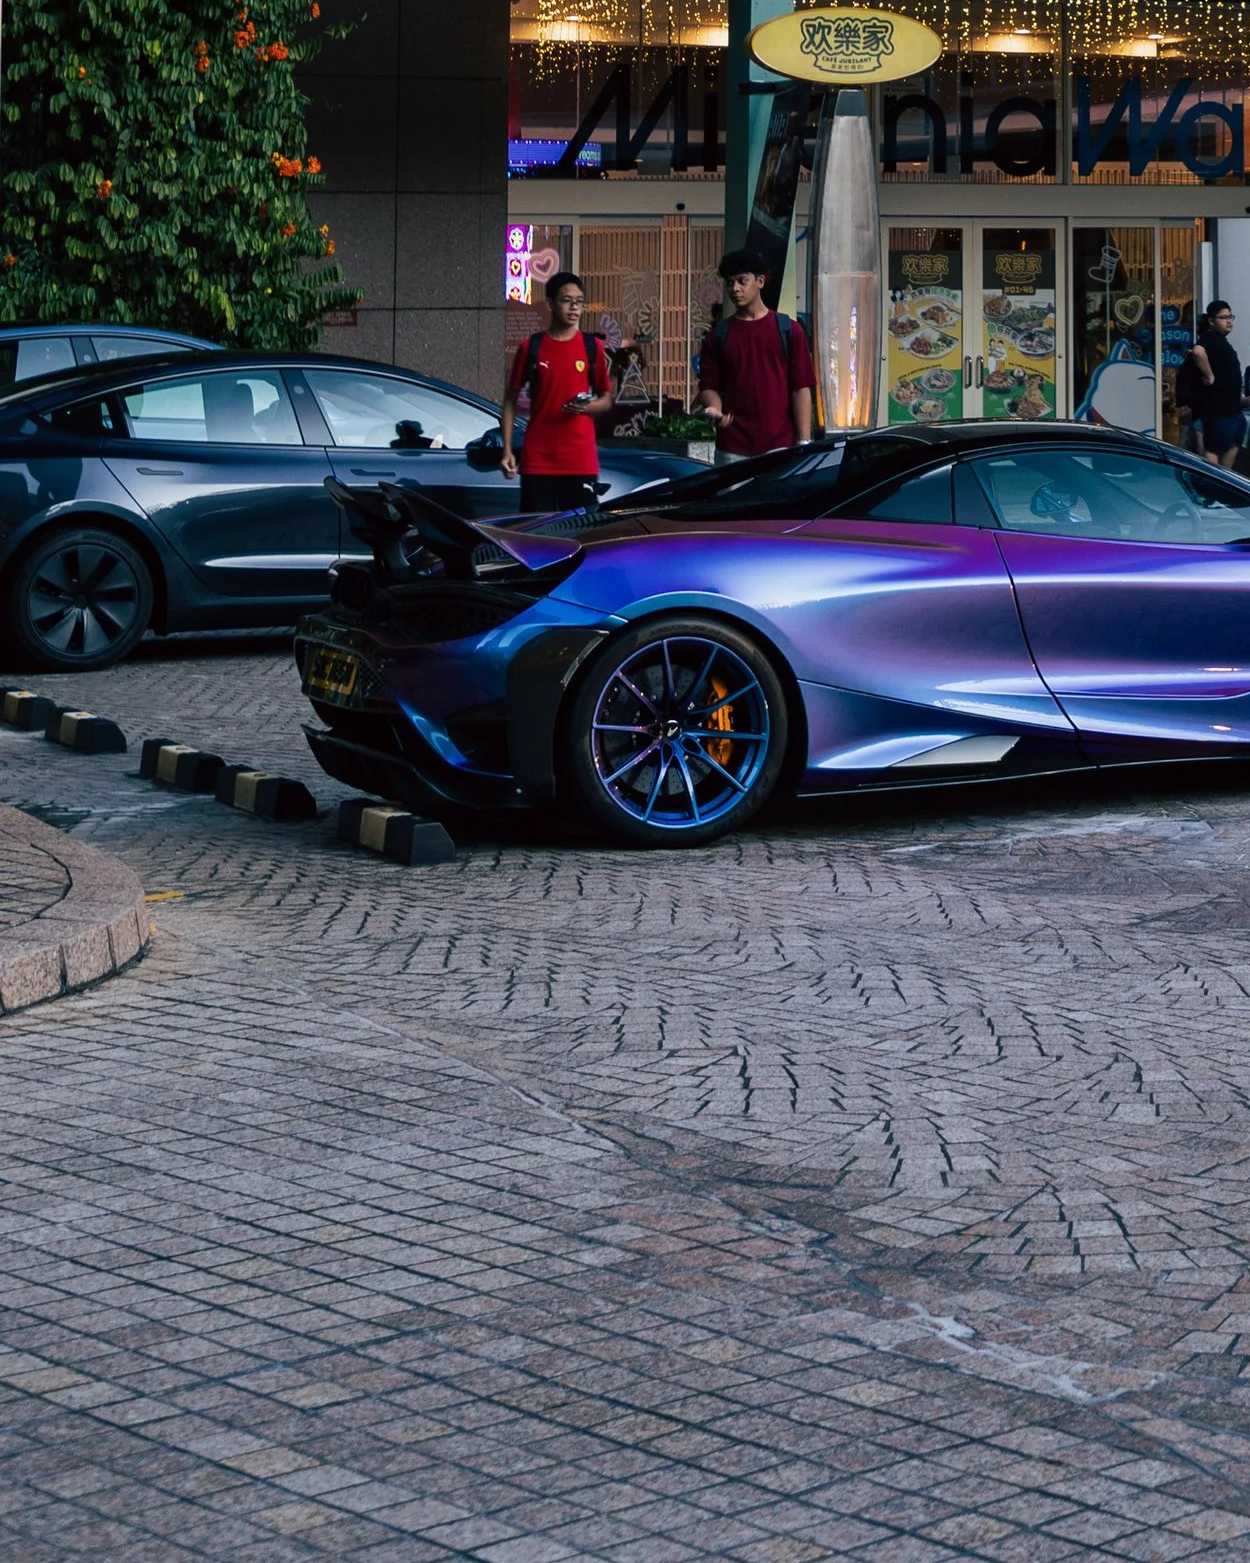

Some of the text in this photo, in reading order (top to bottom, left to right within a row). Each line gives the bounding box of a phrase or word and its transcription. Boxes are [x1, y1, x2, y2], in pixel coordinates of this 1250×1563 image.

[803, 23, 891, 52] 欢樂家
[555, 64, 1056, 176] Minia
